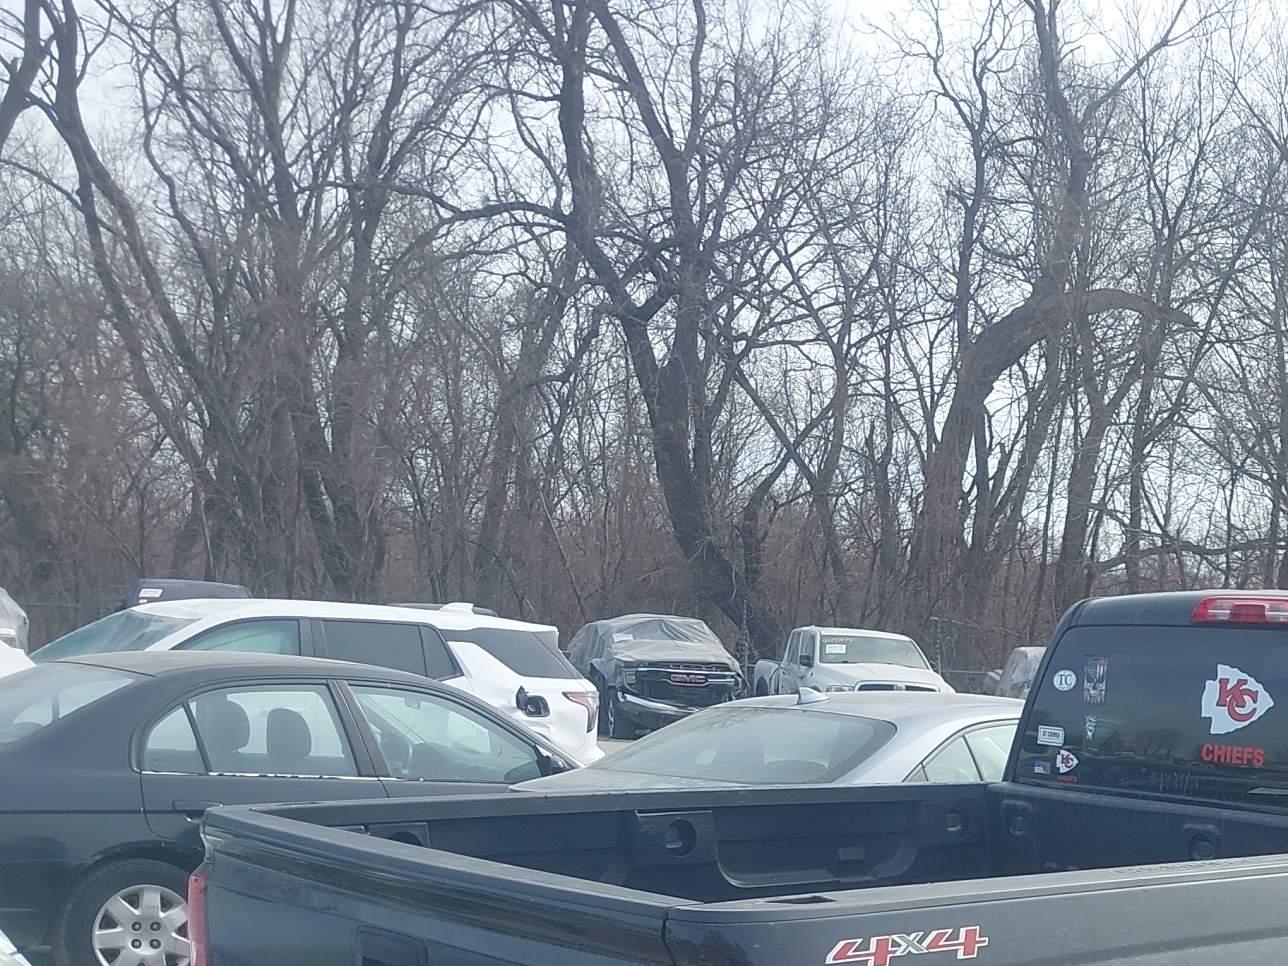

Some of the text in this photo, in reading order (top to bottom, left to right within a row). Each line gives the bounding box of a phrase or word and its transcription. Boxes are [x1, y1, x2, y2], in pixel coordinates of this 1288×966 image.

[670, 674, 706, 683] GMC
[1058, 673, 1073, 687] TC
[1216, 677, 1259, 723] KC
[1201, 743, 1265, 767] CHIEFS
